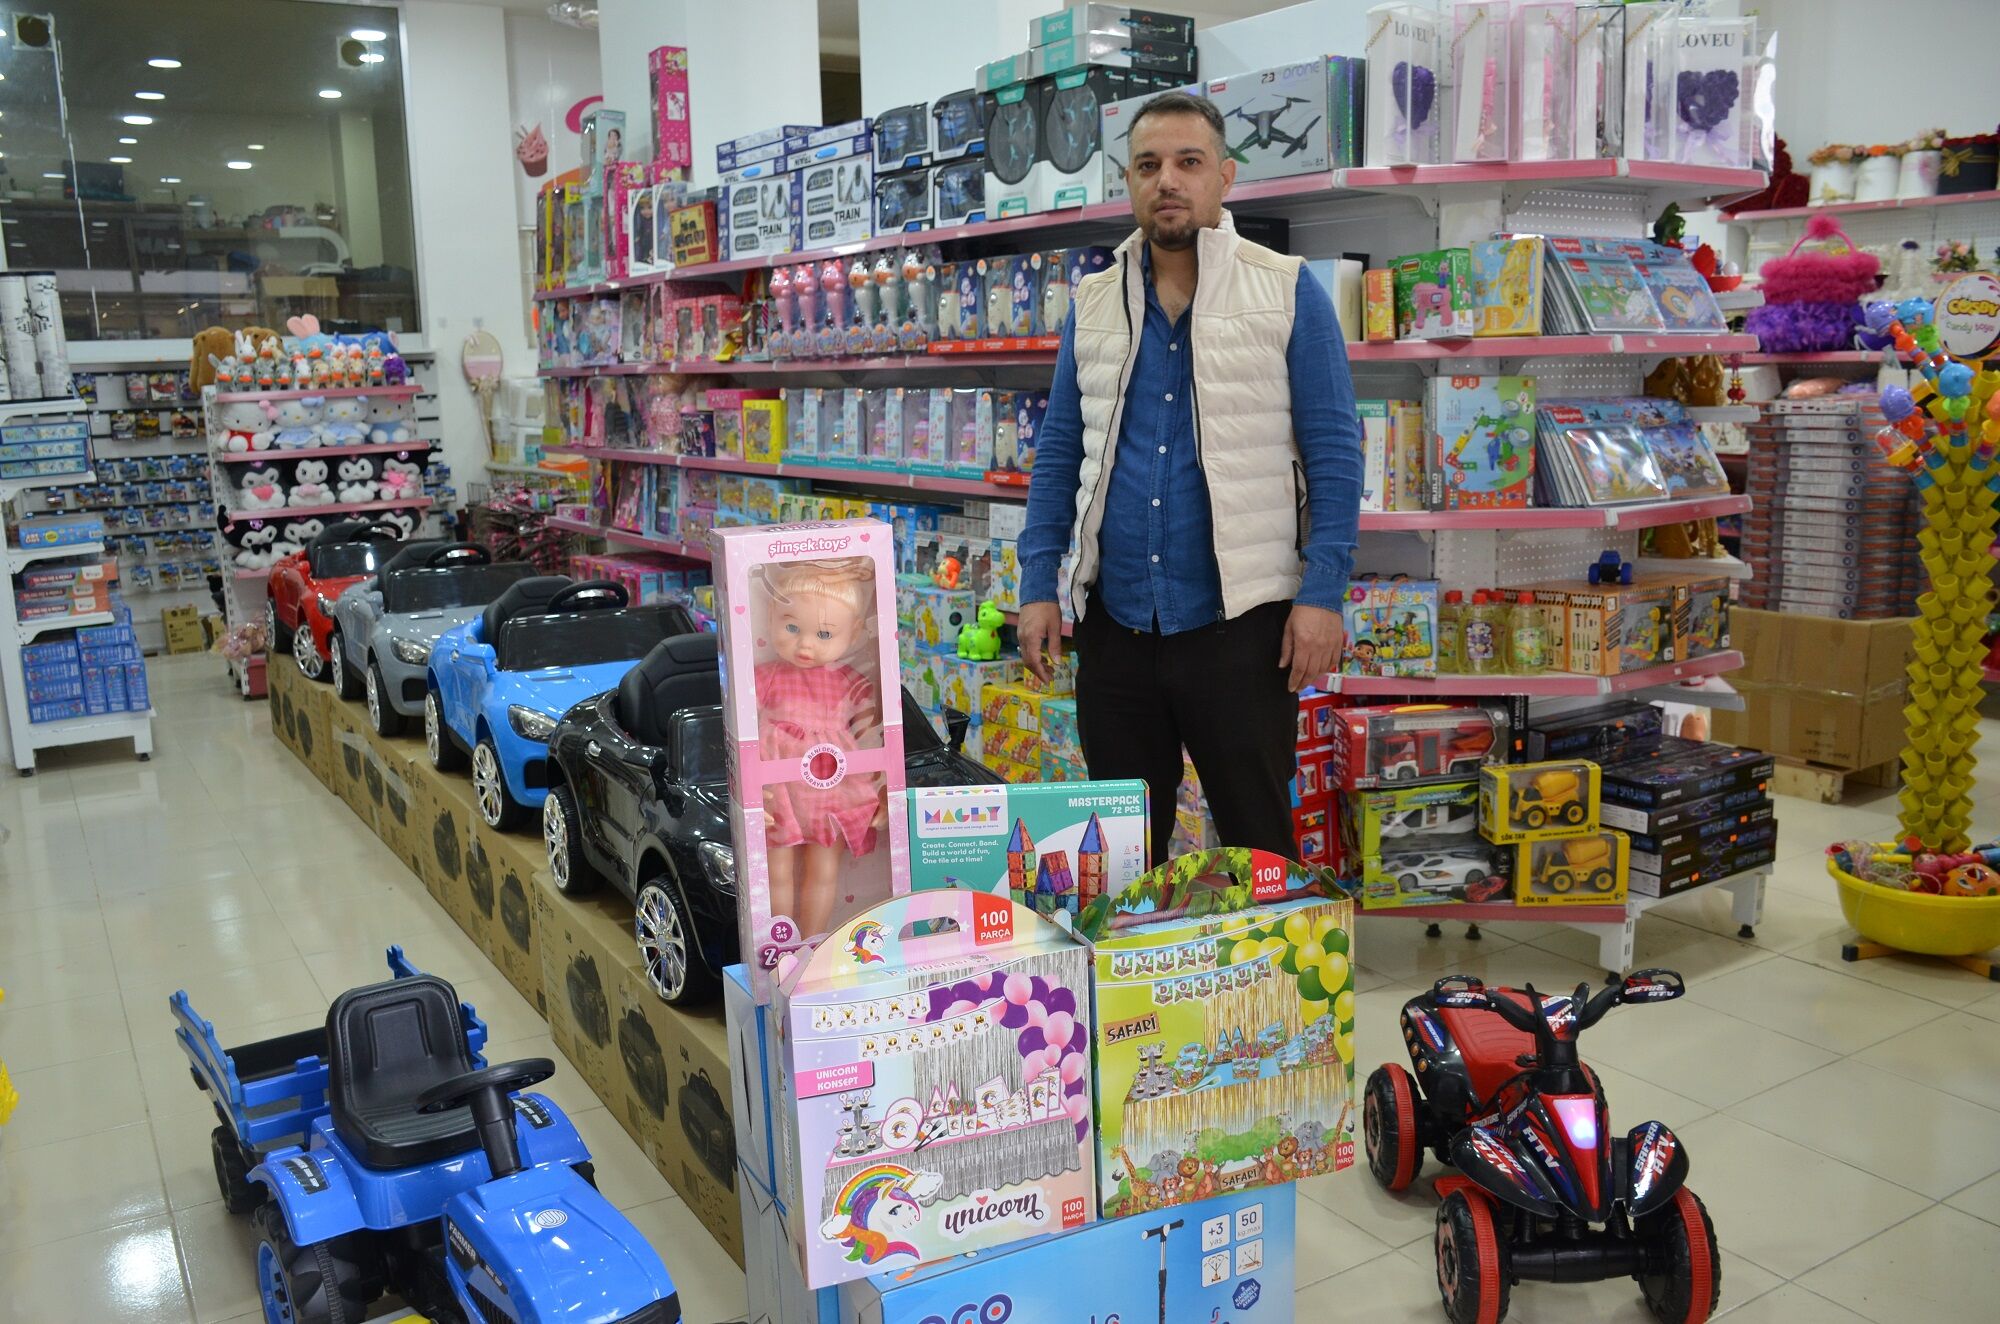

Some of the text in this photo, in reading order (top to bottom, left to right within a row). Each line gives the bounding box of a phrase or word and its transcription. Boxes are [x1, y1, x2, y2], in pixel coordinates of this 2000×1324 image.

[1677, 32, 1735, 48] LOVEU
[834, 208, 861, 222] TRAIN
[758, 224, 782, 237] TRAIN
[1068, 795, 1140, 808] MASTERPACK
[924, 806, 1001, 824] MAGLY
[1111, 805, 1140, 814] 72 PCS
[1134, 870, 1139, 878] E
[1256, 866, 1281, 883] 100
[1255, 883, 1283, 895] PARÇA
[980, 910, 1008, 927] 100
[775, 925, 788, 934] 3+
[980, 928, 1011, 941] PARÇA
[816, 1065, 858, 1080] UNICORN
[817, 1076, 859, 1091] KONSEPT
[1336, 1145, 1354, 1157] 100
[1521, 1126, 1561, 1169] ATV
[1650, 1135, 1673, 1175] ATV
[1474, 1140, 1514, 1175] ATV
[945, 1192, 1044, 1235] unicorn
[1063, 1200, 1082, 1213] 100
[1063, 1212, 1085, 1222] PARÇA
[1241, 1211, 1257, 1227] 50
[1208, 1222, 1224, 1237] +3
[449, 1221, 477, 1260] FARMER
